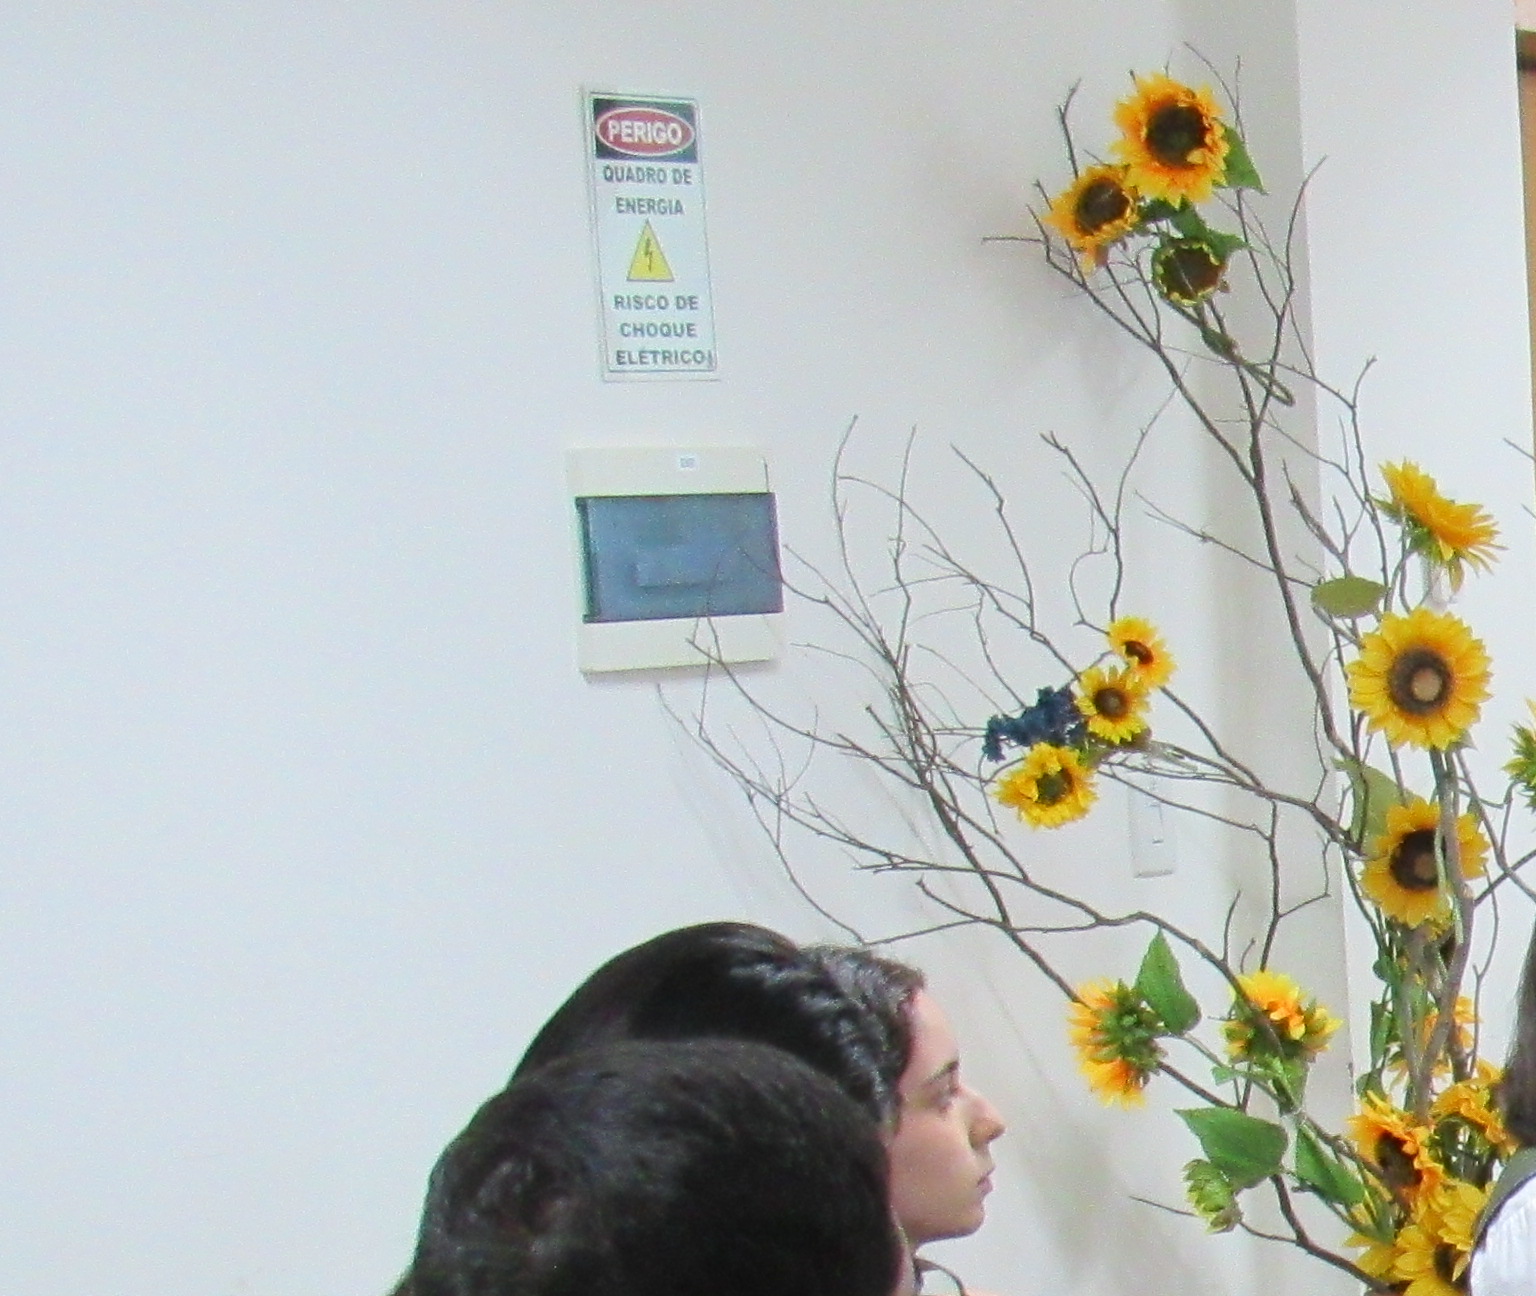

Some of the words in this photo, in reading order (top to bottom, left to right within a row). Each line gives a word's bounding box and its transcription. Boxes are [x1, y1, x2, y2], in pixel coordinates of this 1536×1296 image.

[607, 119, 684, 145] PERIGO
[603, 164, 667, 184] QUADRO
[672, 167, 692, 185] DE
[615, 196, 685, 216] ENERGIA
[613, 294, 670, 310] RISCO
[676, 294, 699, 311] DE
[620, 321, 698, 339] CHOQUE
